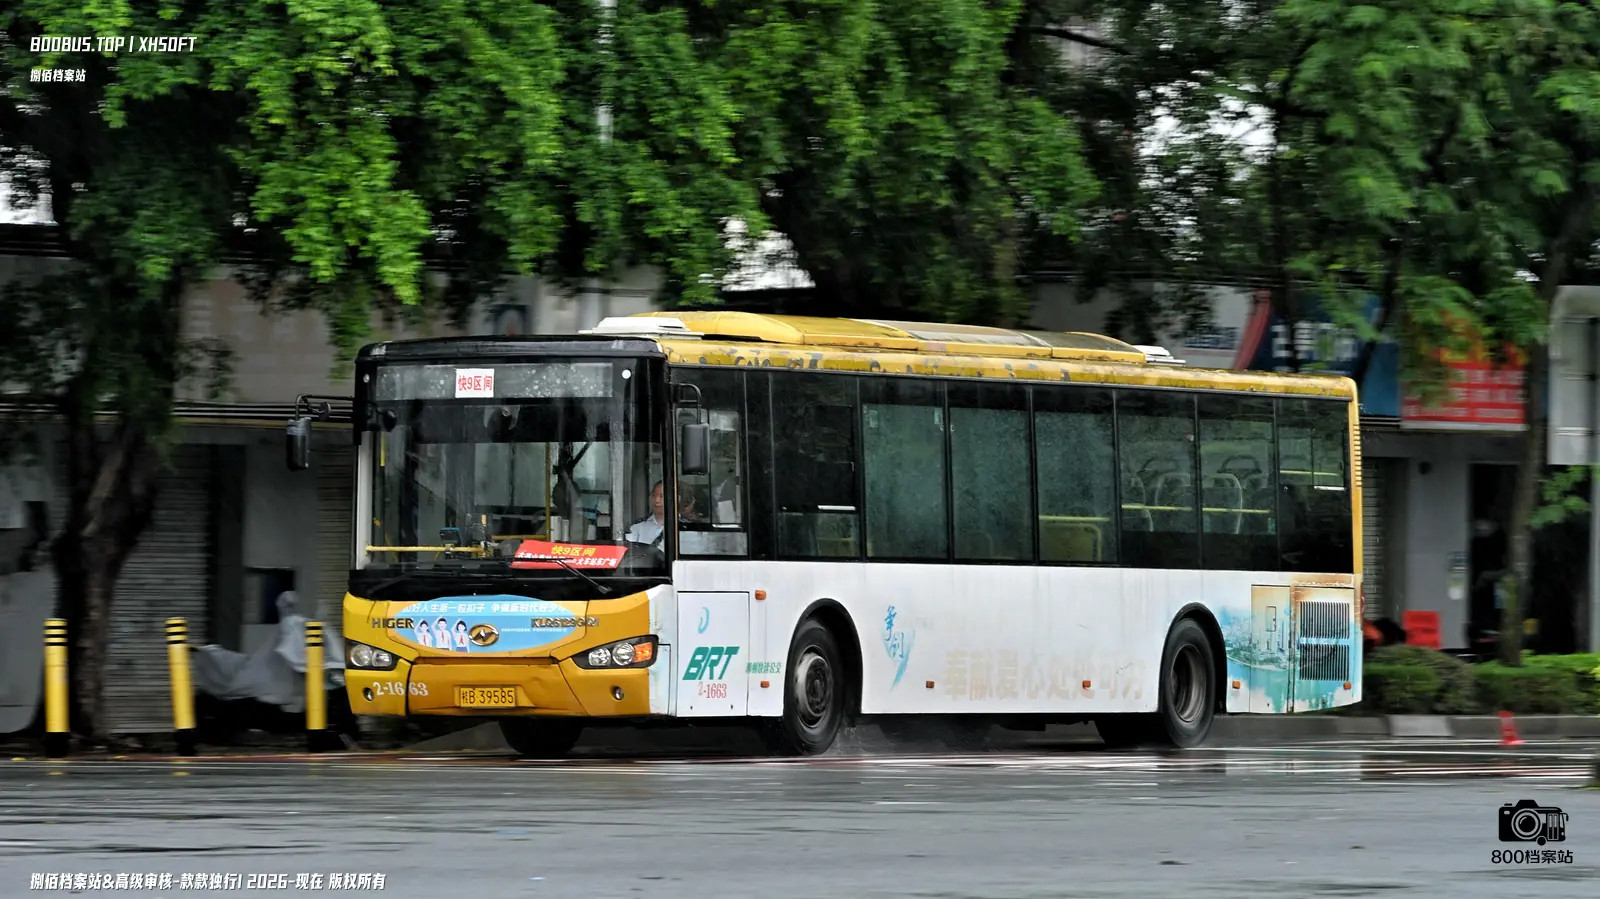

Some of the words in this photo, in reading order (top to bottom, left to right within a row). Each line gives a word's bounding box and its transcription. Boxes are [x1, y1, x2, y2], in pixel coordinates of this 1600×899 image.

[458, 375, 493, 391] 快9区间
[551, 545, 596, 557] 快9区间
[372, 617, 414, 629] HIGER
[682, 646, 740, 680] BRT
[372, 681, 429, 697] 2-1663
[698, 681, 727, 699] 2-1663
